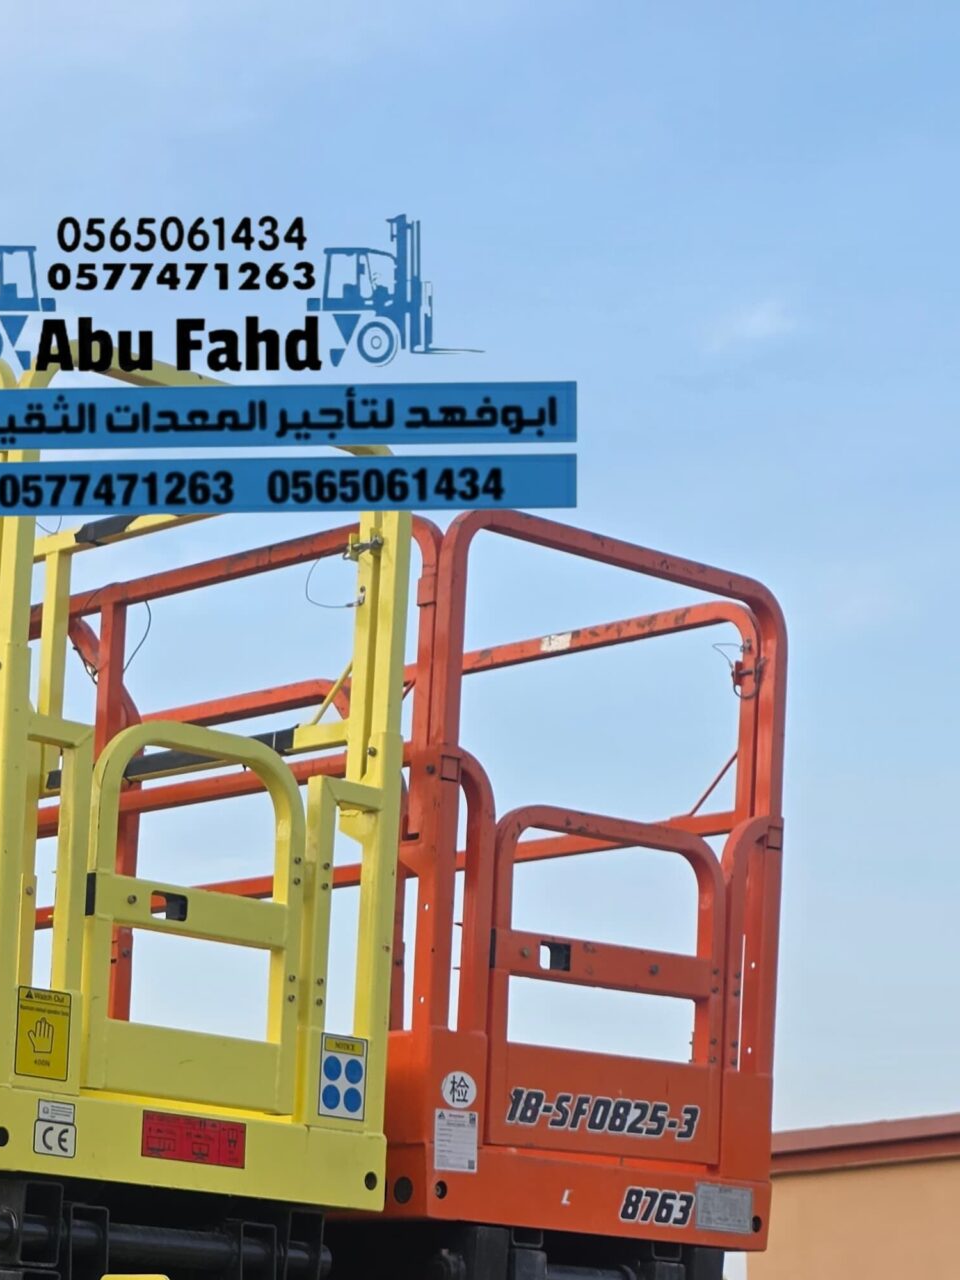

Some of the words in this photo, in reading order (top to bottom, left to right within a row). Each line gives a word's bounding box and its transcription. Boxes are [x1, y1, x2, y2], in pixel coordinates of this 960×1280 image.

[449, 1075, 470, 1103] 检
[507, 1088, 700, 1139] 18-SF0825-3
[620, 1187, 695, 1225] 8763
